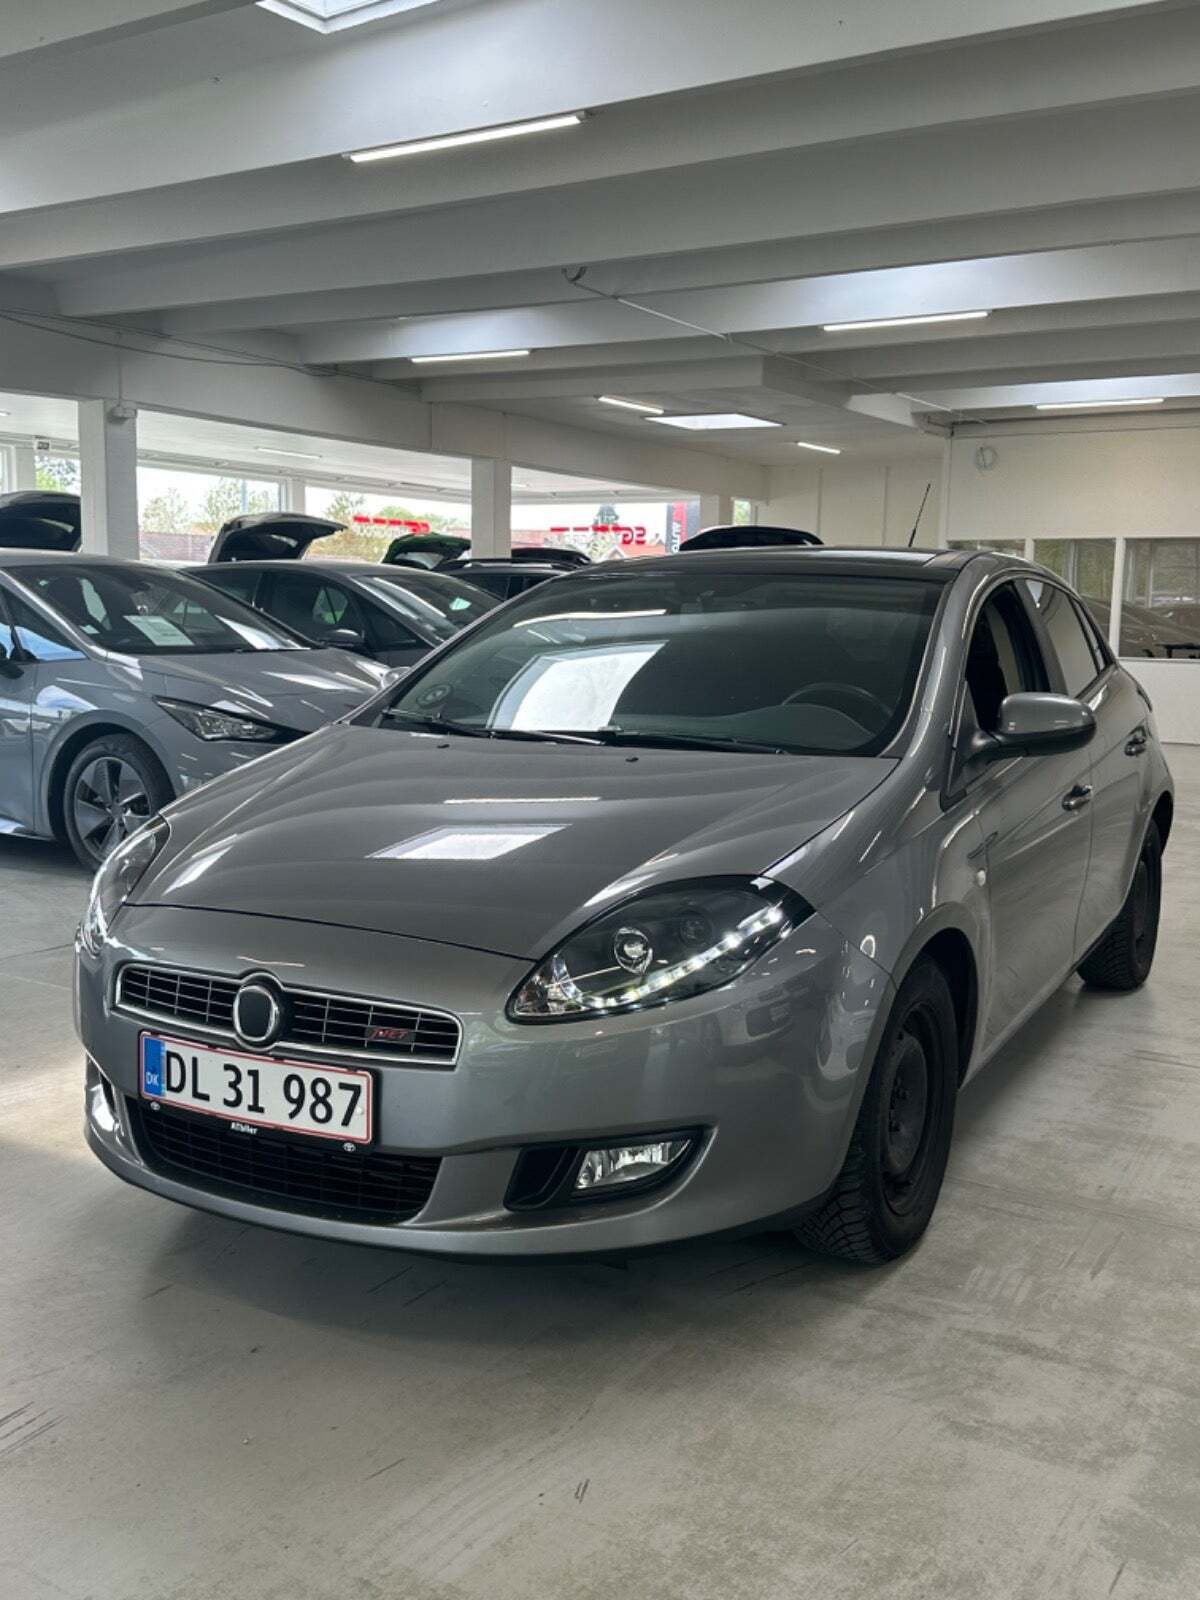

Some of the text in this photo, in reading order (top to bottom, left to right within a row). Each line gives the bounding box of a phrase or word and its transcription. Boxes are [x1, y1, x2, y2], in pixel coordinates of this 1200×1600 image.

[145, 1072, 160, 1087] DK
[166, 1050, 362, 1127] DL 31 987
